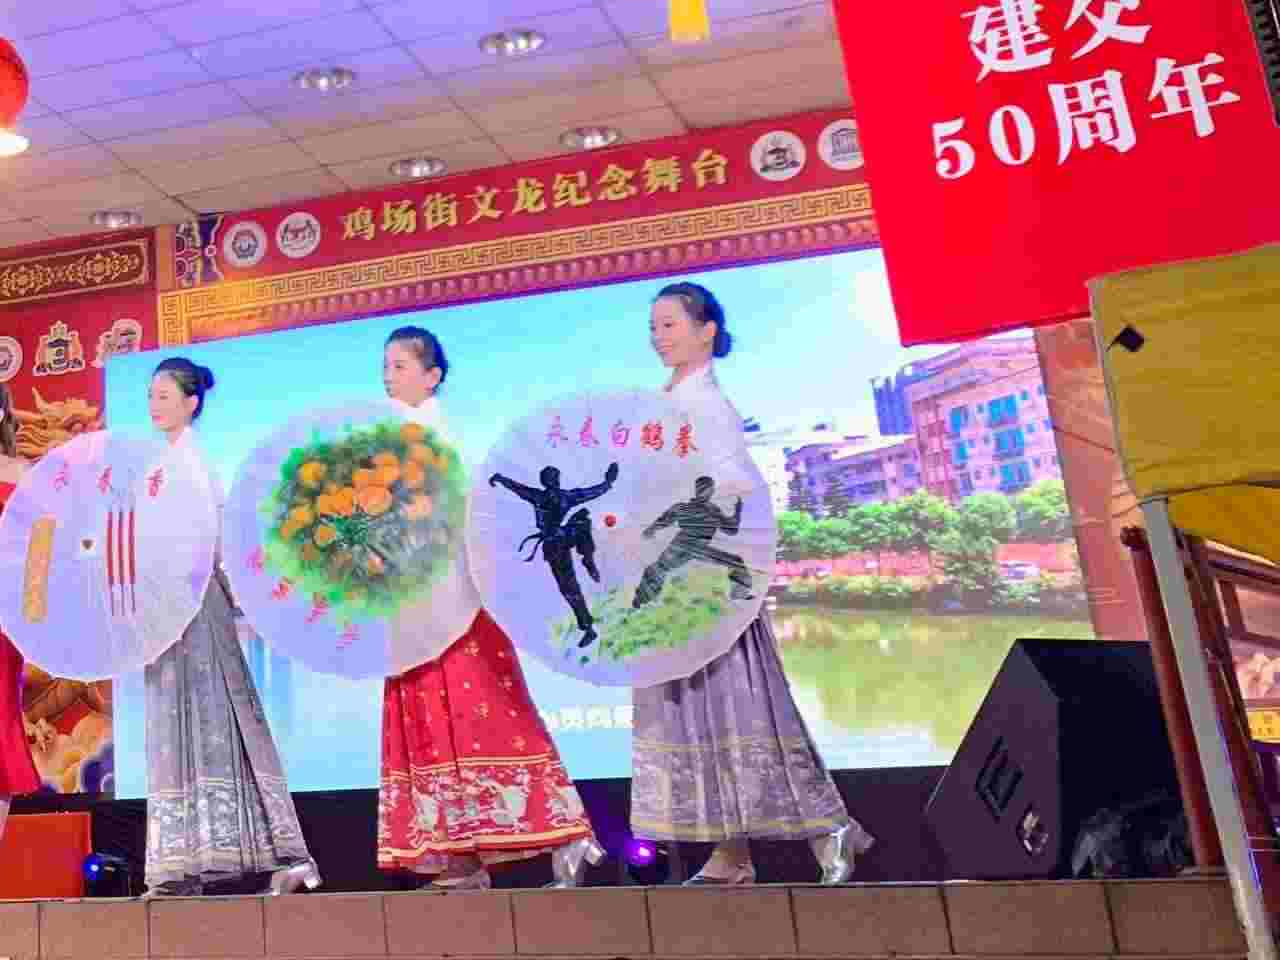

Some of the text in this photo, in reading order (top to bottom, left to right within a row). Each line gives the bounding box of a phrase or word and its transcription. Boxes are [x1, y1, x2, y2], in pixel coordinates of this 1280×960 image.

[931, 53, 1241, 180] 50周年
[341, 148, 730, 241] 鸡场街文龙纪念舞台
